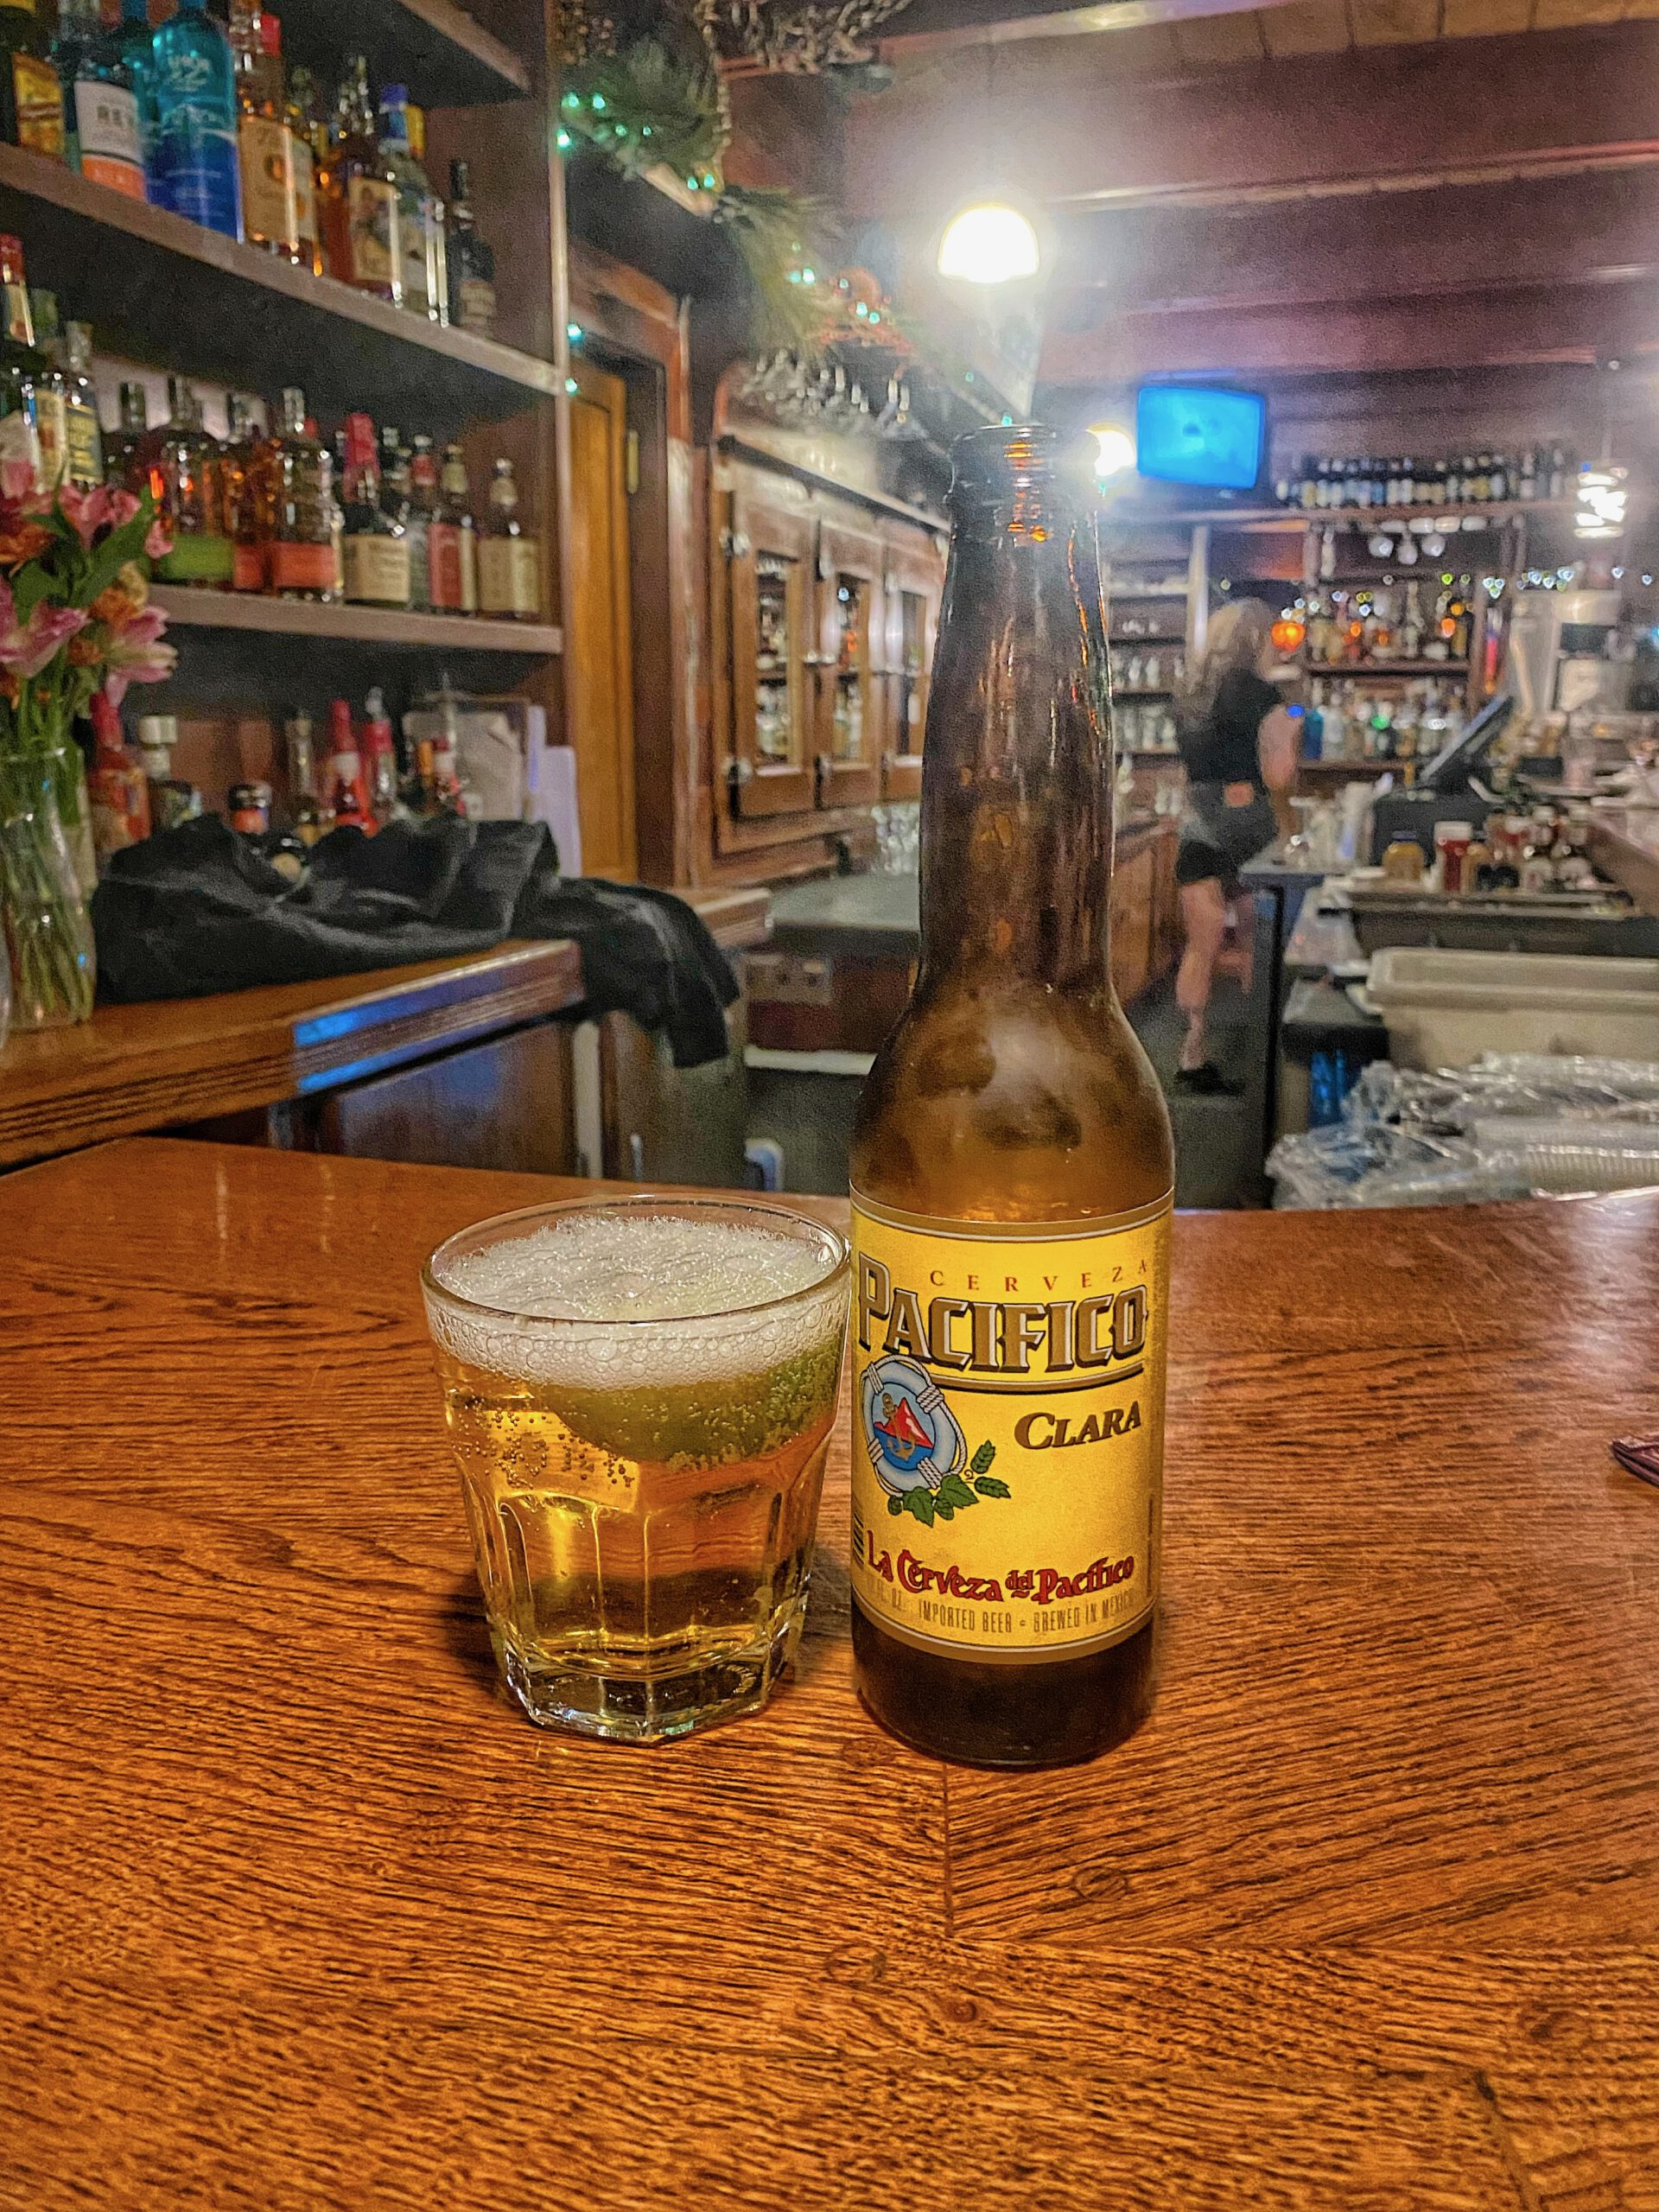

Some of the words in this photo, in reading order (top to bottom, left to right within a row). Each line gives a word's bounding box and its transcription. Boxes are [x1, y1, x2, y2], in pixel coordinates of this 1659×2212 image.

[930, 1259, 1147, 1293] CERVEZA
[857, 1250, 1148, 1373] PACIFICO
[1014, 1401, 1142, 1450] CLARA
[897, 1548, 1004, 1602] Cerveza
[1005, 1569, 1036, 1599] del
[918, 1600, 976, 1631] IMPORTED
[982, 1611, 1012, 1633] BEER
[1033, 1606, 1080, 1632] BREWED
[1085, 1602, 1097, 1624] IN
[1102, 1588, 1135, 1618] MEXI
